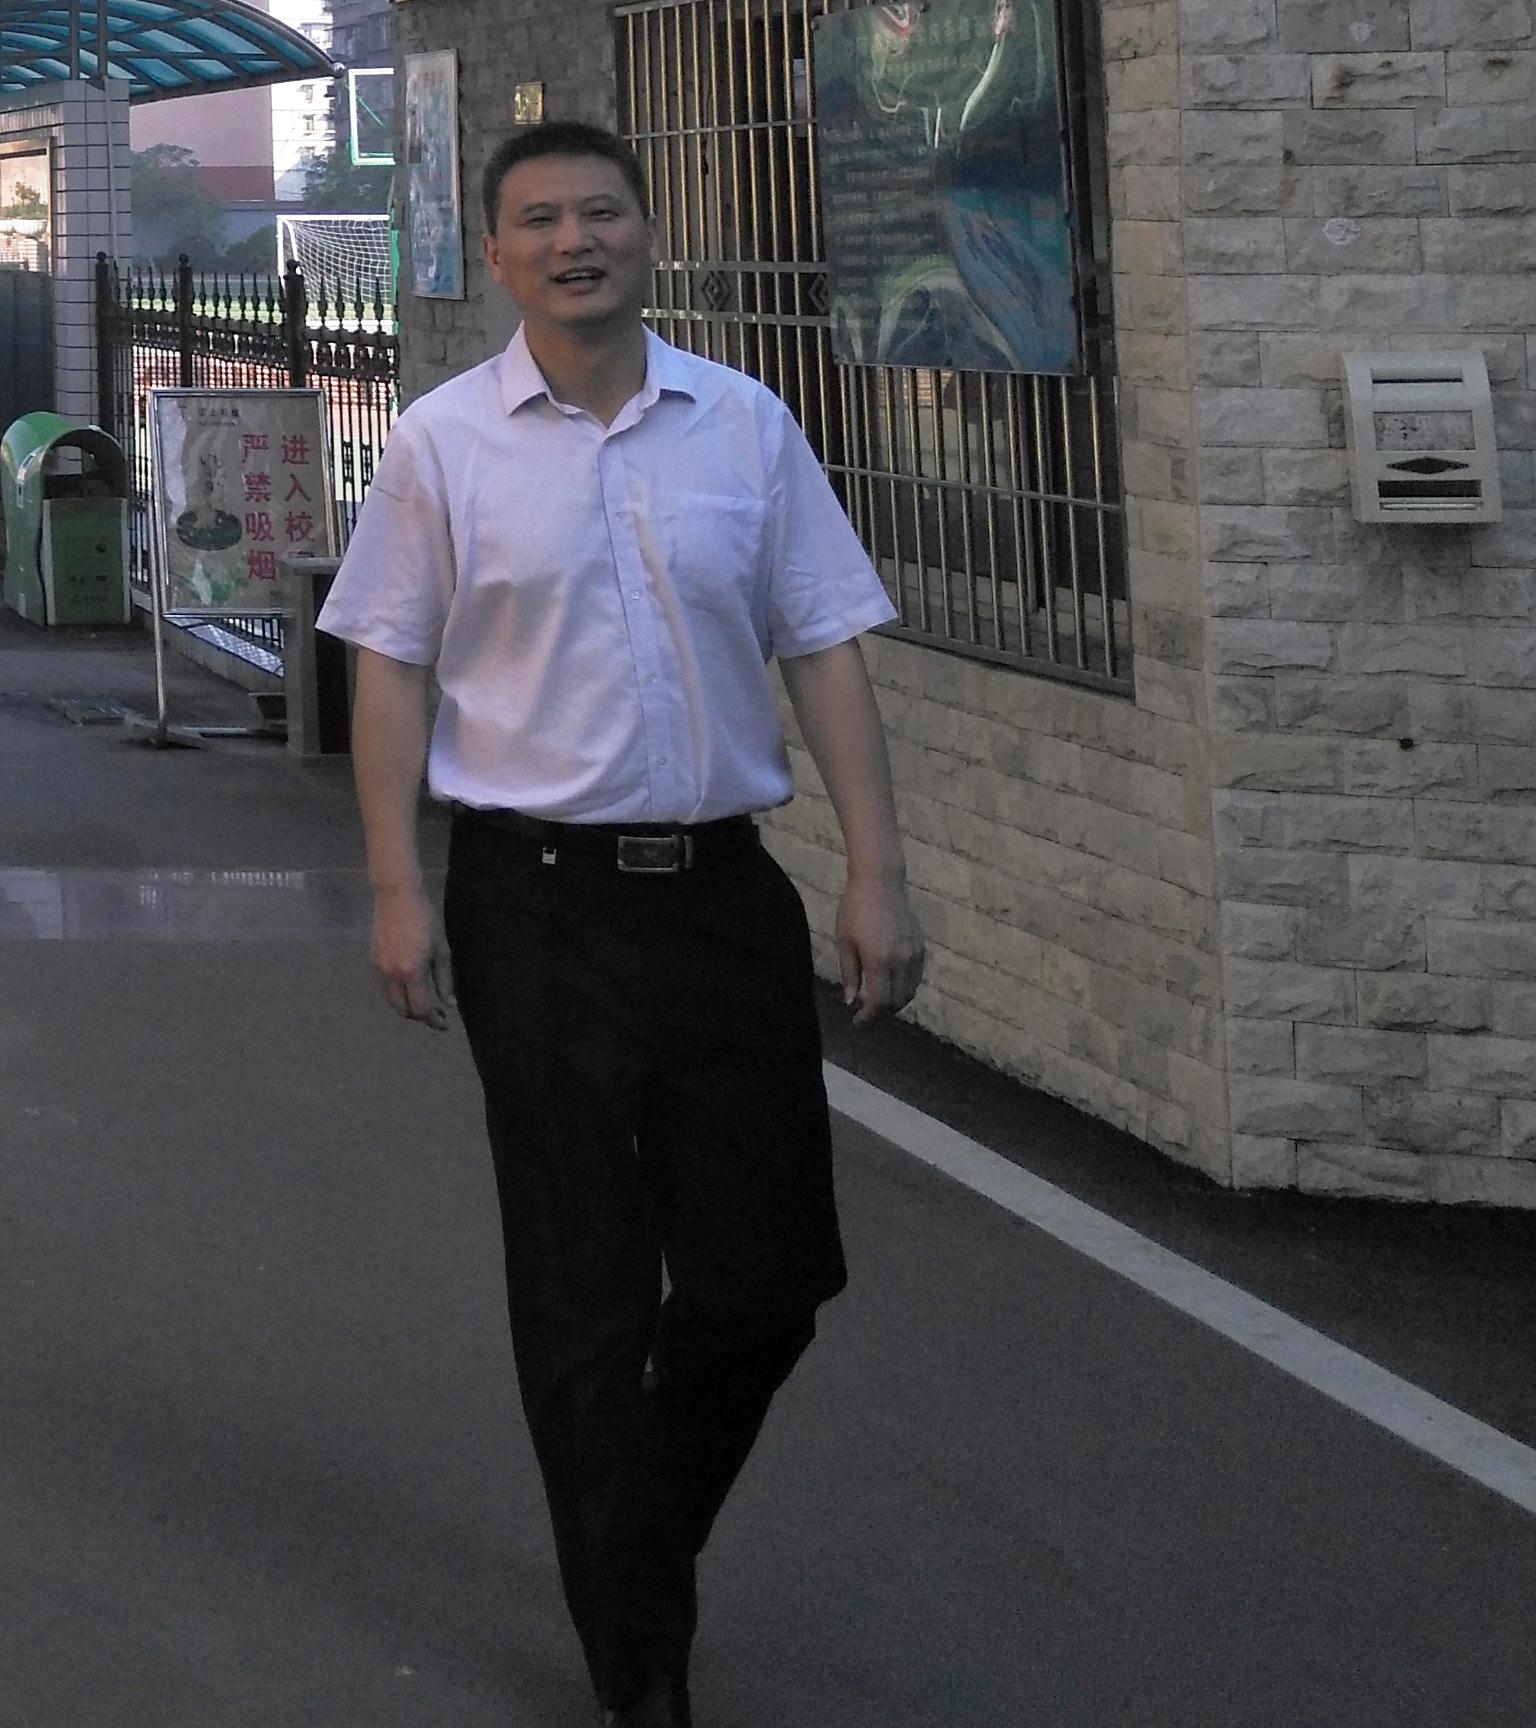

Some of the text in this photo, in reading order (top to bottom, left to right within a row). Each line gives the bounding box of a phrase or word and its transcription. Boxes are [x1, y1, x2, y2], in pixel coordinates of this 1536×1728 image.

[240, 433, 277, 582] 严禁吸烟
[281, 434, 315, 559] 进入校
